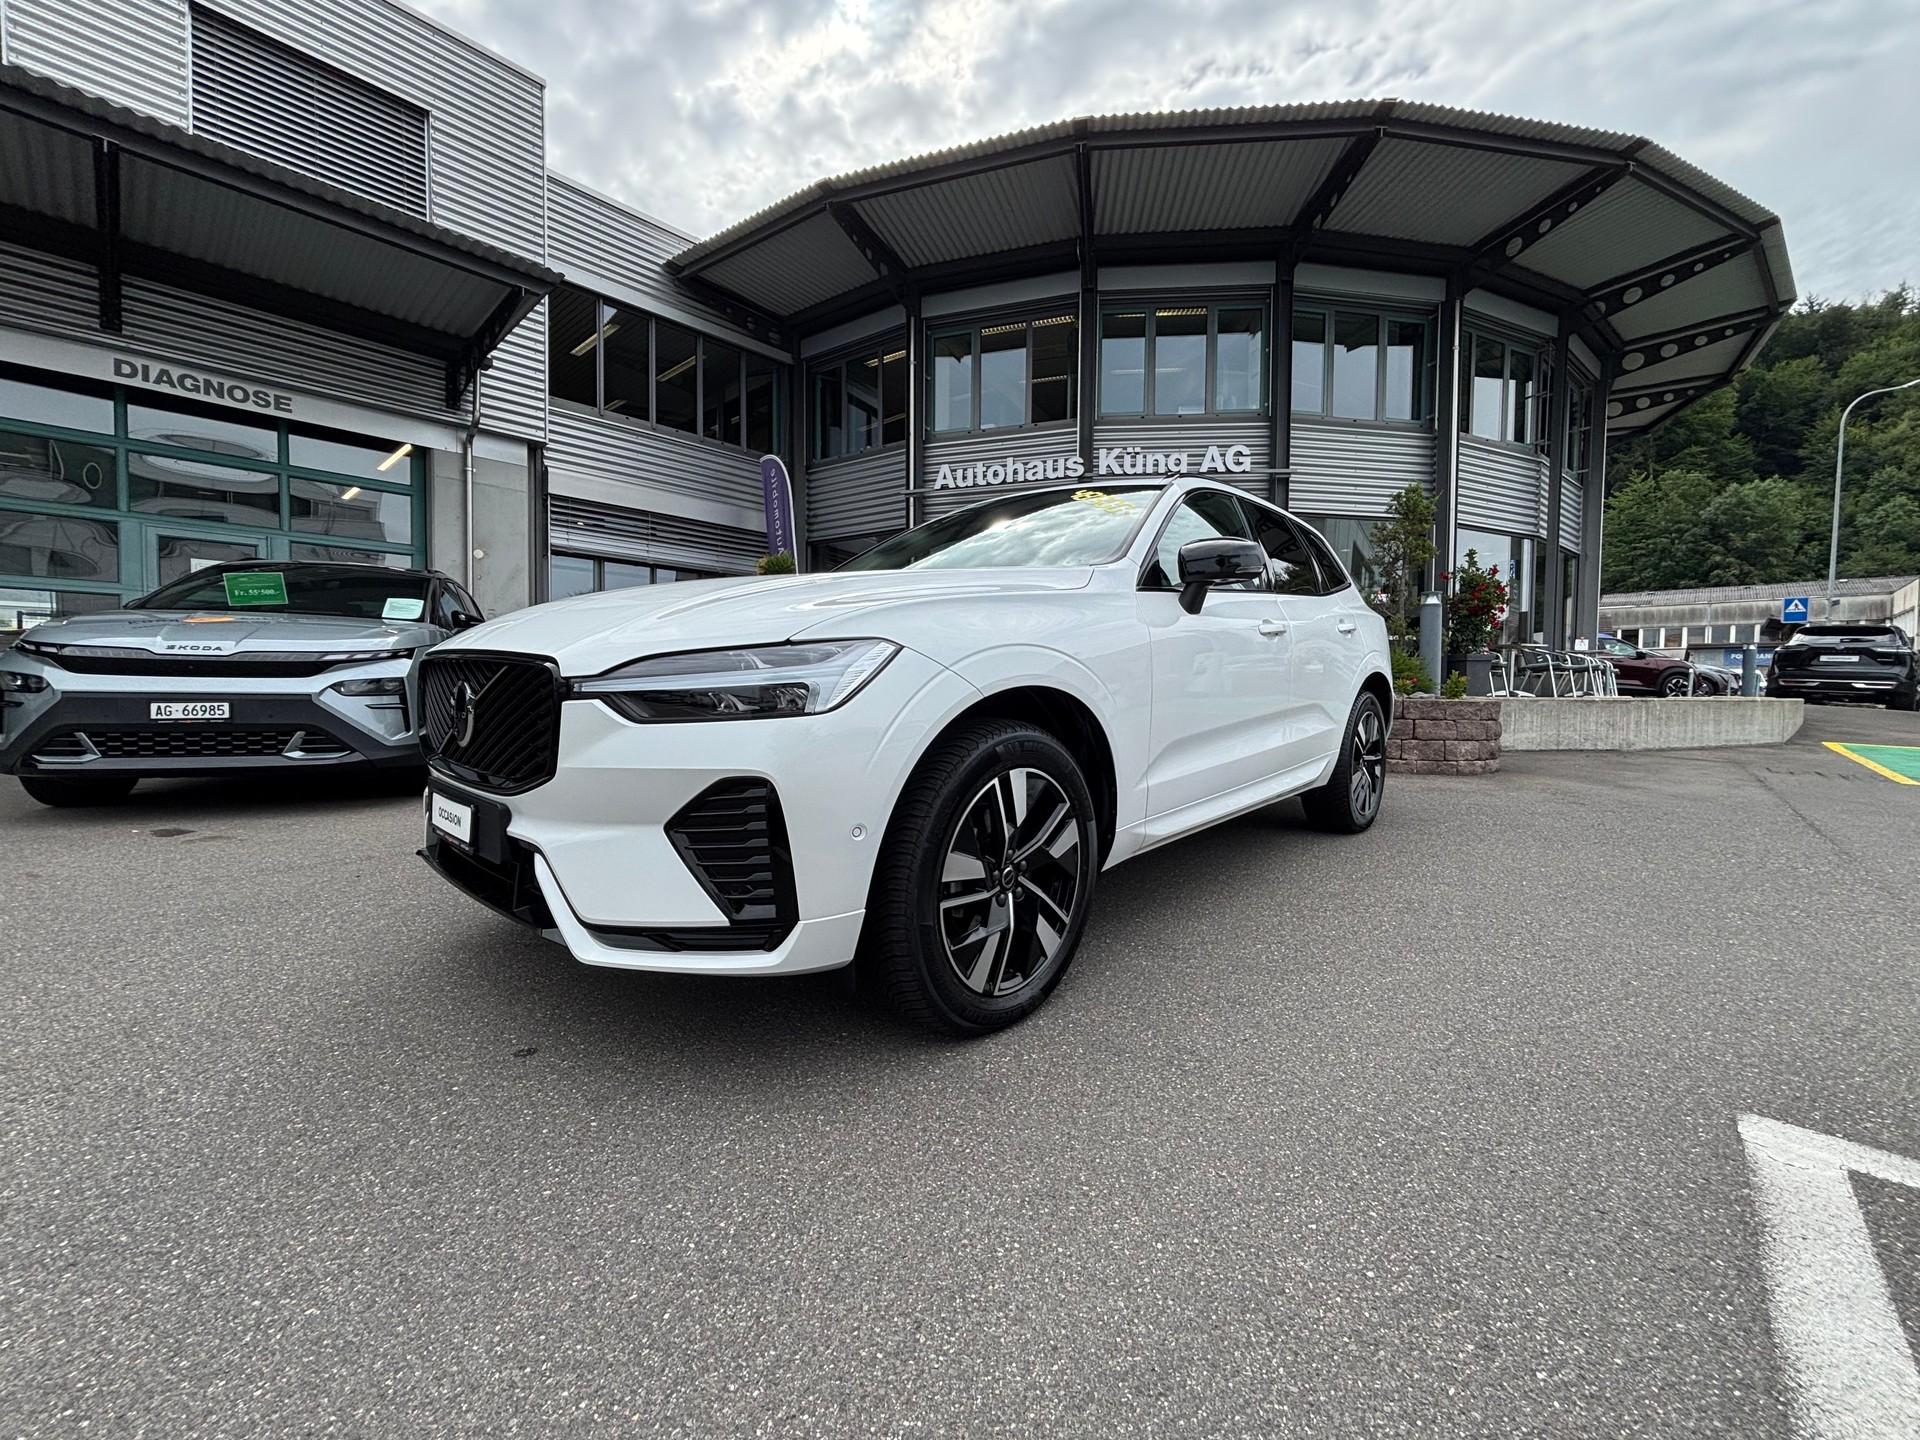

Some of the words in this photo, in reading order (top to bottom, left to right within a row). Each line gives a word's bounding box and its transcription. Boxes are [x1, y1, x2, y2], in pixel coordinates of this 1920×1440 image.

[113, 357, 293, 414] DIAGNOSE
[933, 455, 1085, 490] Autohaus
[1098, 447, 1187, 475] Küng
[1199, 444, 1252, 474] AG
[438, 806, 462, 828] OCCASION
